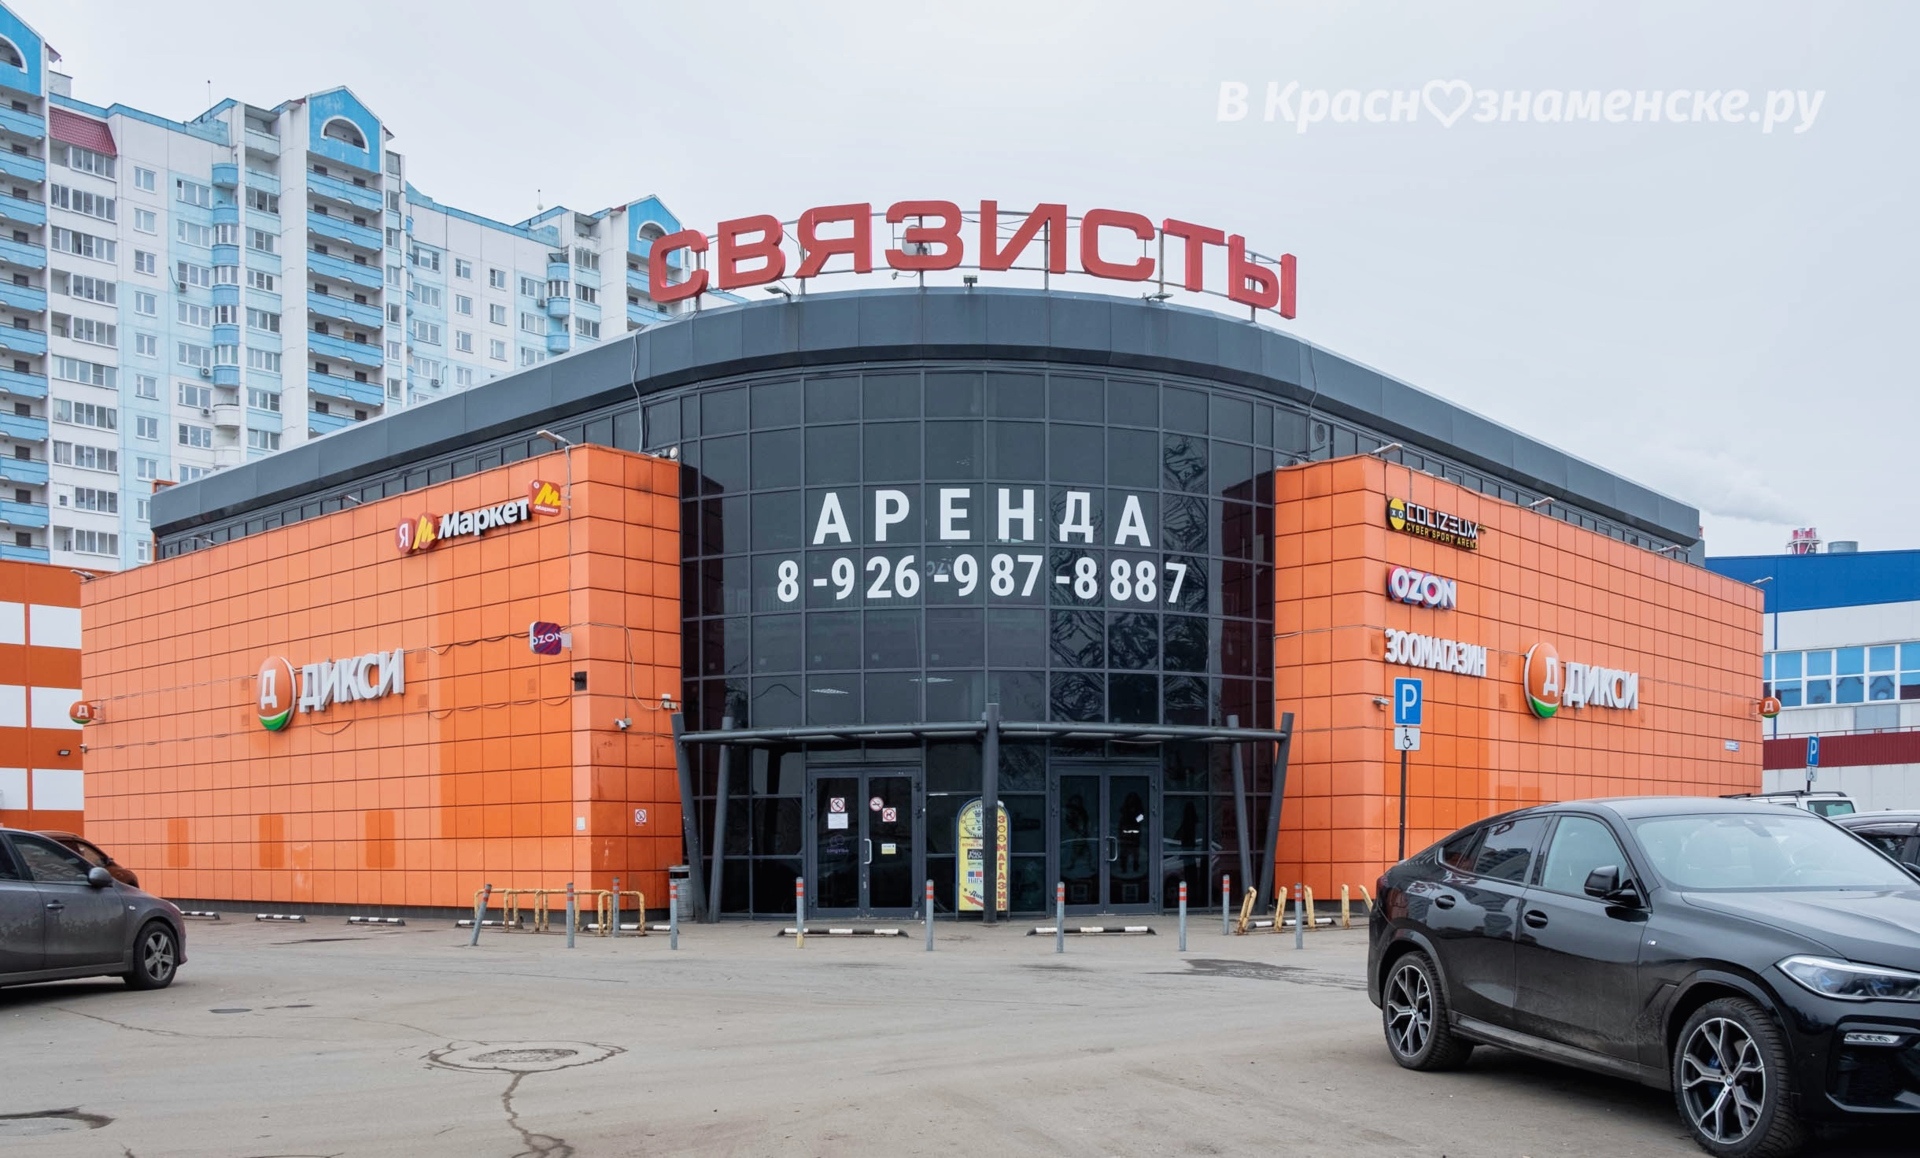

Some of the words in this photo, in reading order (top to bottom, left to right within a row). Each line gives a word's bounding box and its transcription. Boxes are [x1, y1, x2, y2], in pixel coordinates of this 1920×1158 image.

[648, 200, 1297, 319] СВЯЗИСТЫ
[437, 498, 530, 539] Маркет
[812, 488, 1151, 547] АРЕНДА
[1406, 502, 1478, 539] COLIZEUM
[1406, 522, 1429, 536] CYBER
[1431, 531, 1454, 545] SPORT
[1391, 568, 1457, 608] OZON
[1385, 629, 1487, 677] ЗООМАГАЗИН
[260, 669, 277, 709] Д
[299, 648, 404, 713] ДИКСИ
[1543, 657, 1558, 697] Д
[1563, 662, 1638, 710] ДИКСИ
[77, 705, 89, 717] Д
[1402, 683, 1418, 720] P
[1763, 701, 1774, 712] Д
[1810, 740, 1817, 762] P
[997, 816, 1007, 909] ЗООМАГАЗИН
